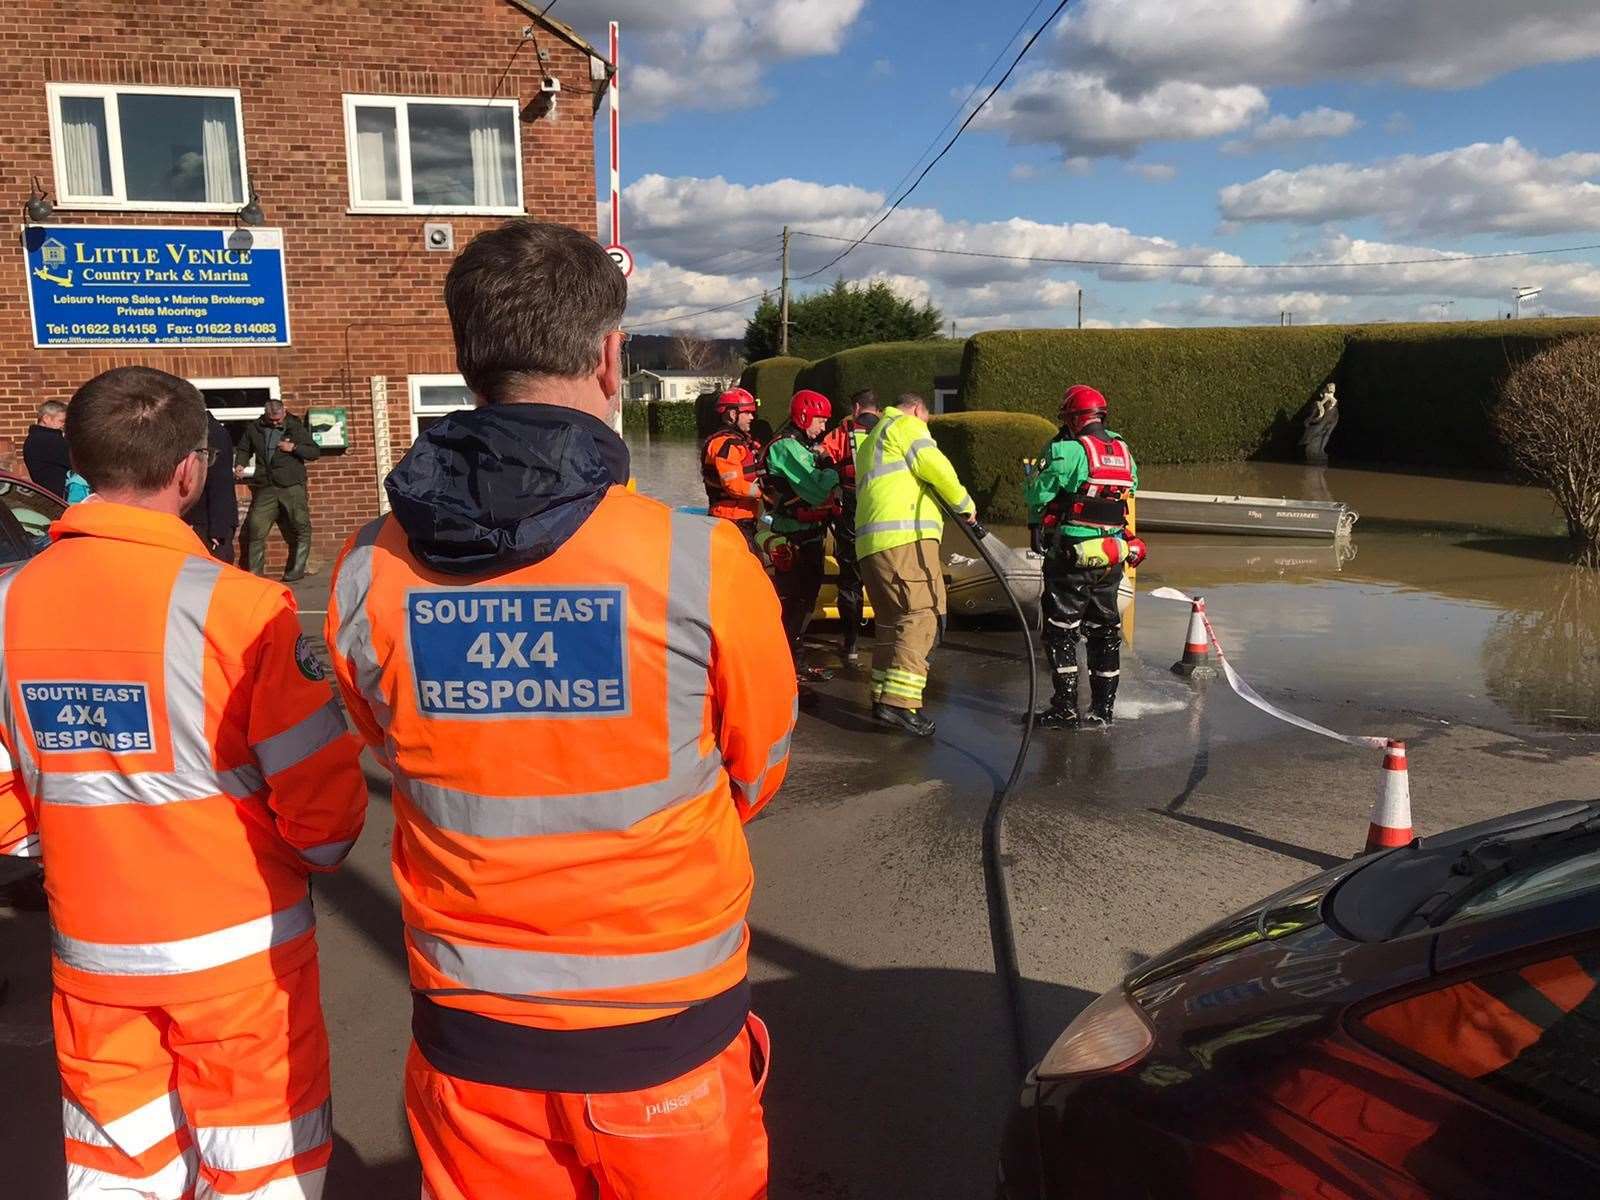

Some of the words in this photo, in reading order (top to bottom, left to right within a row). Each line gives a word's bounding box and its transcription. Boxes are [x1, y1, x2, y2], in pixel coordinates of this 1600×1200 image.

[73, 241, 160, 265] LITTLE
[165, 243, 253, 266] VENICE
[82, 268, 141, 284] Country
[146, 269, 178, 282] Park
[181, 270, 195, 282] &
[199, 269, 249, 282] Marina
[53, 294, 94, 305] Leisure
[96, 295, 129, 305] Home
[132, 295, 161, 305] Sales
[172, 295, 209, 305] Marine
[211, 295, 265, 307] Brokerage
[117, 307, 155, 317] Private
[157, 307, 208, 318] Moorings
[46, 323, 69, 335] Tel:
[71, 323, 110, 335] 01622
[112, 323, 158, 335] 814158
[167, 323, 193, 335] Fax:
[195, 323, 232, 335] 01622
[415, 599, 522, 624] SOUTH
[534, 597, 614, 622] EAST
[466, 631, 559, 669] 4X4
[26, 687, 87, 701] SOUTH
[92, 688, 141, 702] EAST
[419, 679, 621, 710] RESPONSE
[56, 704, 108, 727] 4X4
[34, 730, 150, 749] RESPONSE
